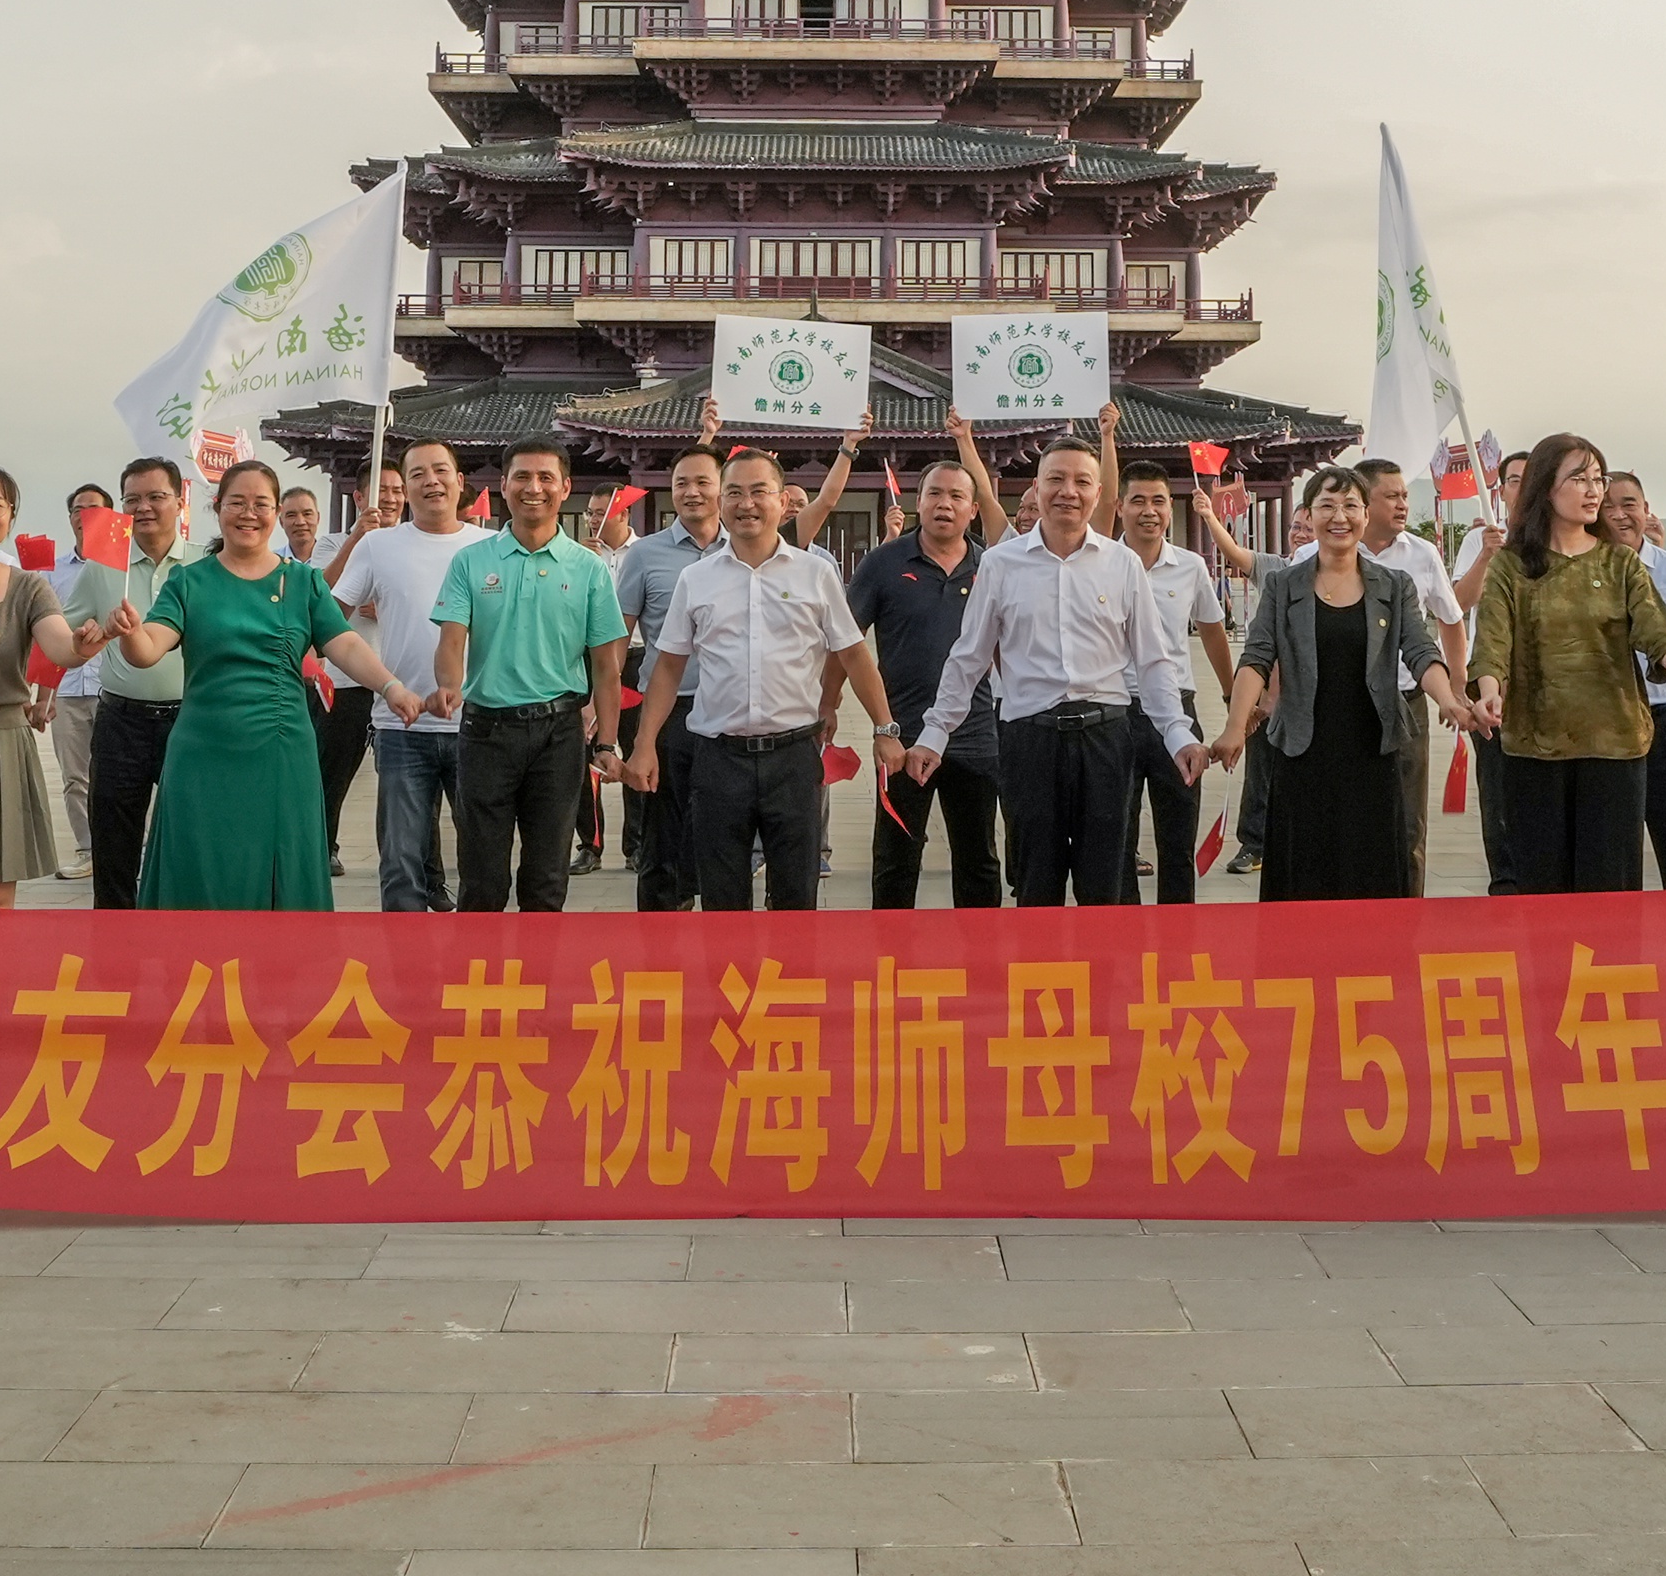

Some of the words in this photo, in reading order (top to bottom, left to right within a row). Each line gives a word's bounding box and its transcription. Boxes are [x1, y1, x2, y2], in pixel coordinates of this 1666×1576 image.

[726, 327, 858, 382] 海南师范大学校友会
[965, 321, 1097, 375] 海南师范大学校友会
[754, 397, 822, 416] 儋州分会
[997, 394, 1064, 408] 儋州分会
